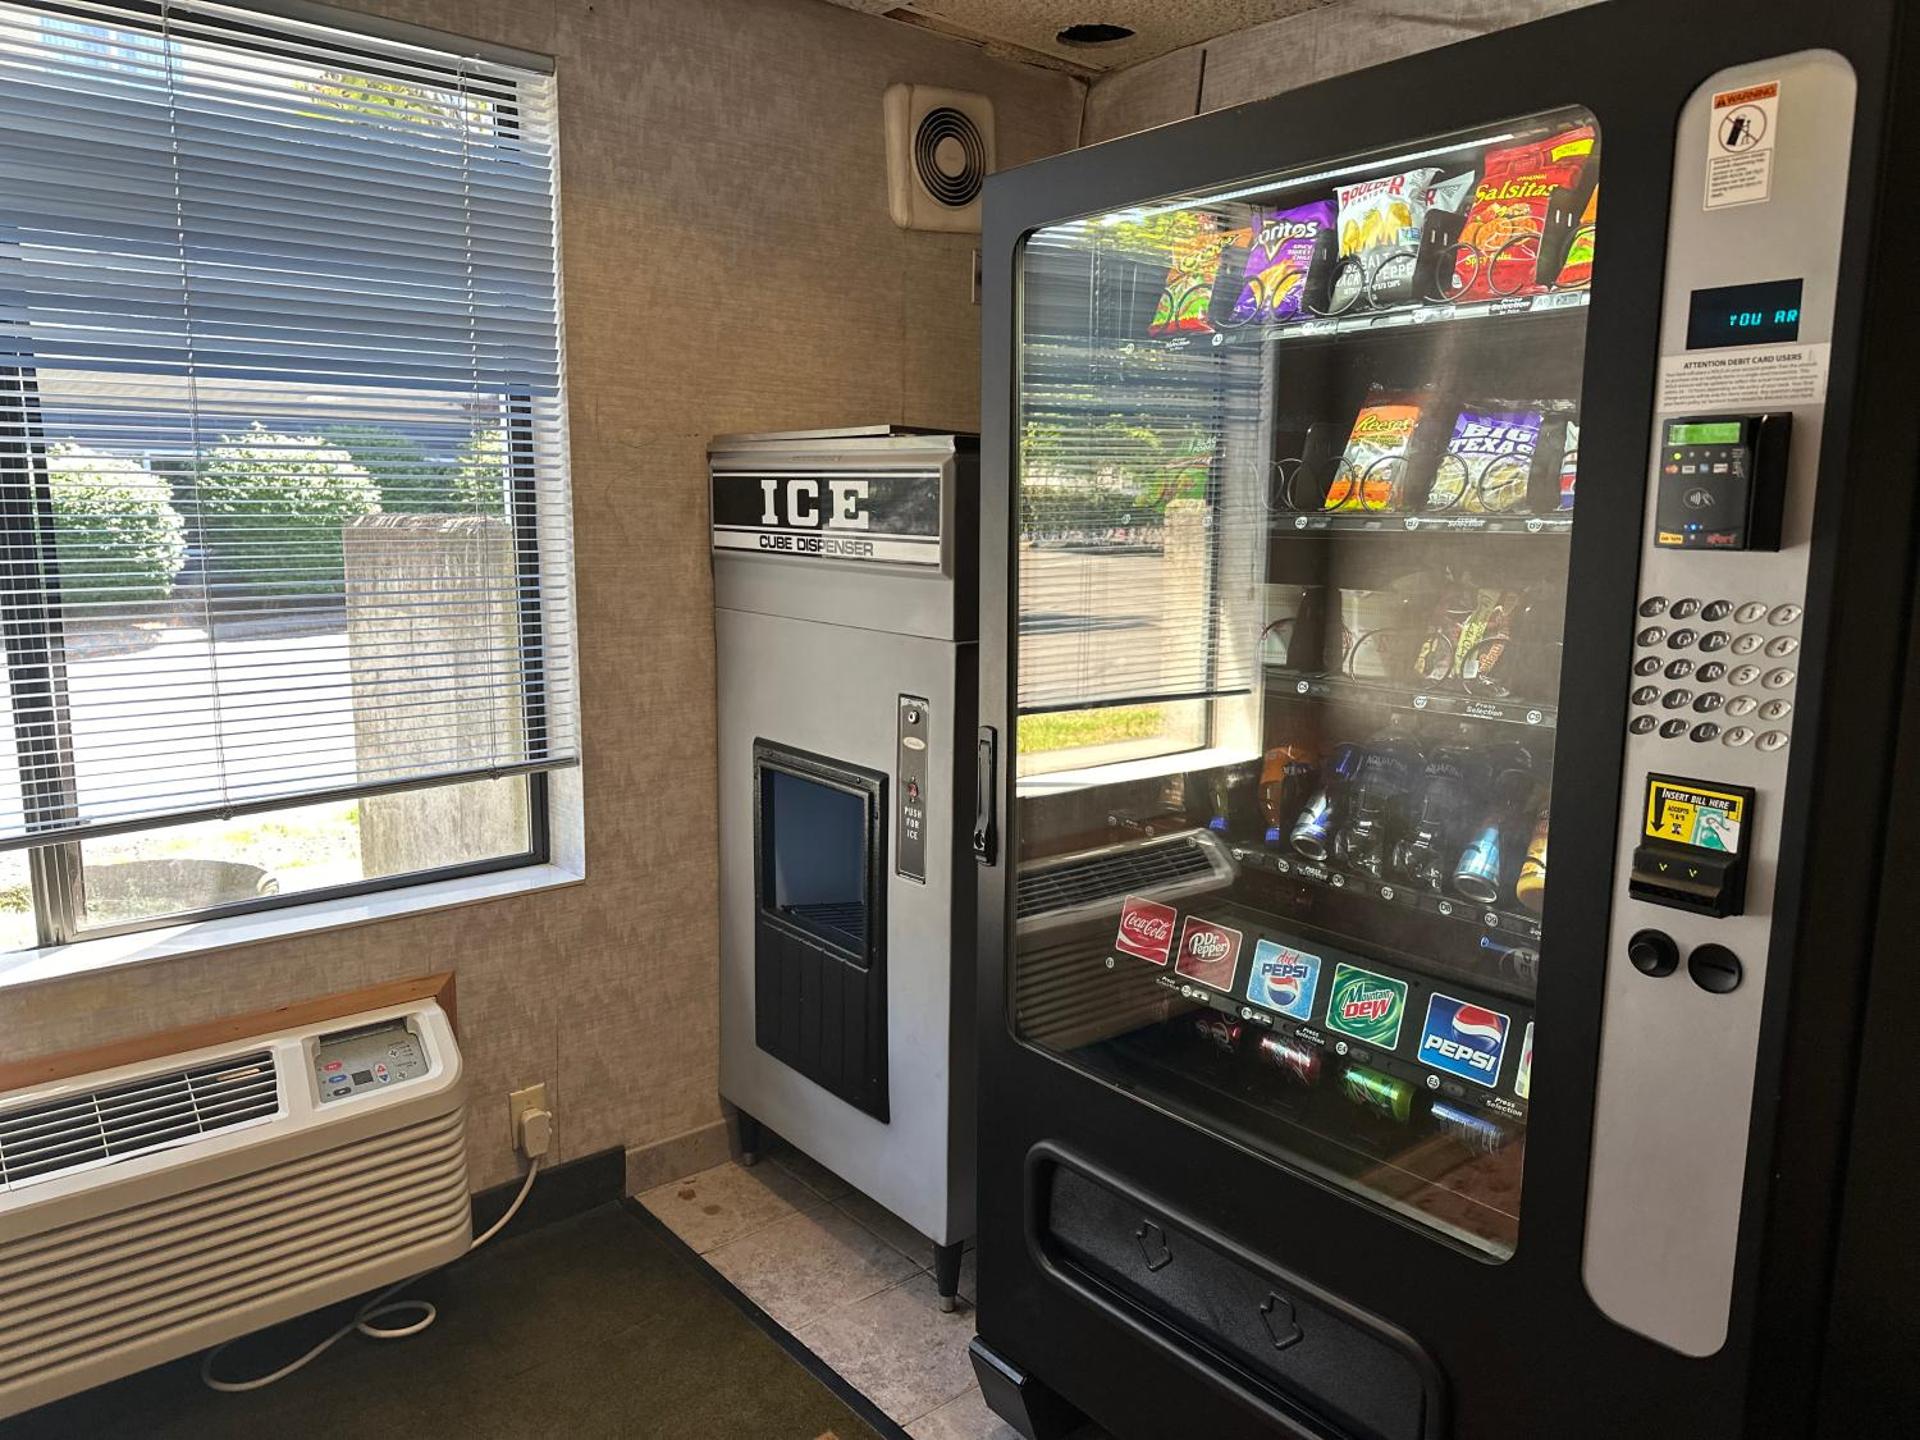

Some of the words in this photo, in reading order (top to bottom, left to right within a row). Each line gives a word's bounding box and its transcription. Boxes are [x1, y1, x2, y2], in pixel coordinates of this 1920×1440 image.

[1475, 179, 1559, 201] Salsitas
[1730, 312, 1762, 327] YOU
[1684, 359, 1726, 369] ATTENTION
[1728, 357, 1750, 366] DEBIT
[1752, 355, 1774, 364] CARD
[1776, 353, 1802, 362] USERS
[1462, 423, 1532, 442] BIG
[1449, 437, 1533, 455] TEXAS
[761, 479, 869, 529] ICE
[759, 534, 793, 550] CUBE
[796, 537, 874, 556] DISPENSER
[1466, 705, 1503, 717] Selection
[1662, 788, 1689, 802] INSERT
[1690, 793, 1706, 806] BILL
[1709, 798, 1730, 810] HERE
[904, 806, 922, 818] PUSH
[906, 817, 919, 829] FOR
[907, 828, 918, 840] ICE
[1190, 932, 1228, 958] Pepper
[1205, 932, 1220, 945] Dr
[1261, 963, 1309, 979] PEPSI
[1295, 1030, 1325, 1045] Selection
[1302, 1027, 1320, 1038] Press
[1424, 1034, 1497, 1072] PEPSI
[1486, 1100, 1523, 1117] Selection
[1495, 1097, 1515, 1108] Press
